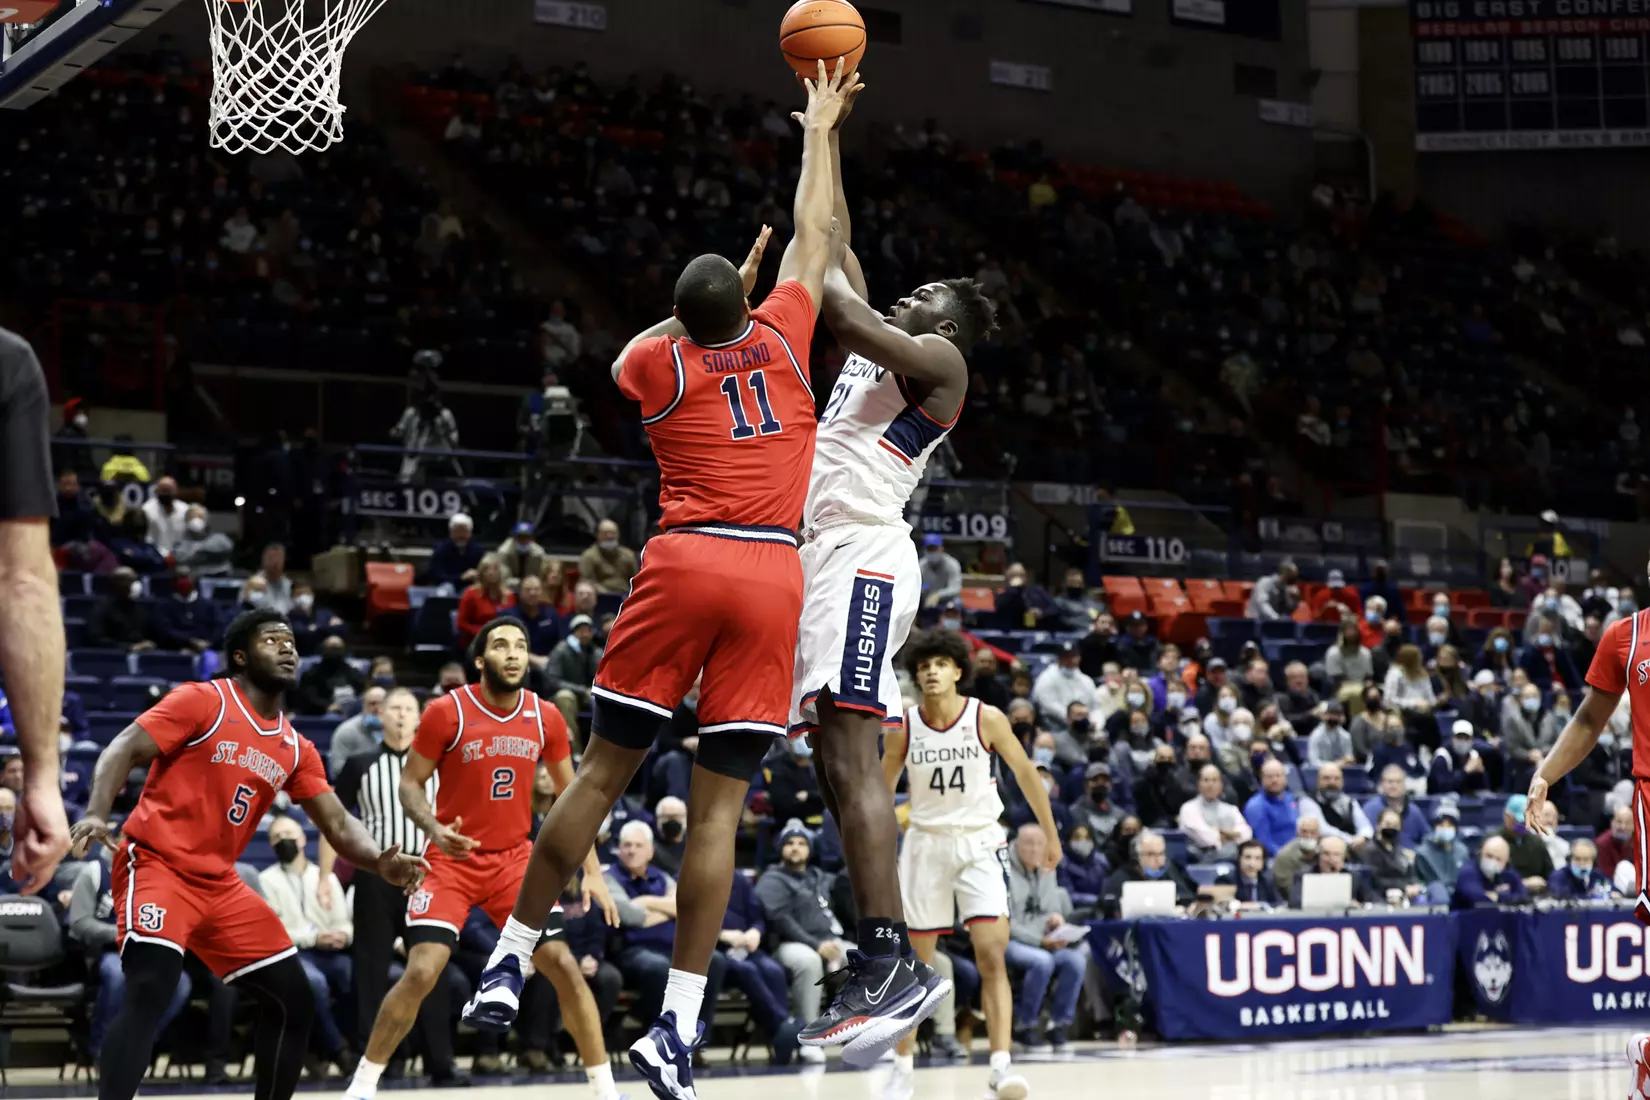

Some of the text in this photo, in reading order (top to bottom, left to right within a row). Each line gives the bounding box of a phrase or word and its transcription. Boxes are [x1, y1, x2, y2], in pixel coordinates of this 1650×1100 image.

[1416, 0, 1461, 18] BIG
[1474, 0, 1540, 16] EAST
[703, 343, 771, 374] SORIANO
[840, 357, 887, 383] CONN
[720, 369, 783, 441] 11
[820, 382, 854, 424] 21
[360, 487, 461, 516] SEC 109
[923, 513, 1007, 540] SEC 109
[1108, 536, 1185, 562] SEC 110
[854, 583, 880, 692] HUSKIES
[485, 736, 540, 762] JOHN'S
[911, 745, 979, 764] UCONN
[238, 746, 288, 793] JOHN'S
[490, 767, 515, 801] 2
[929, 765, 965, 796] 44
[227, 783, 257, 826] 5
[875, 927, 893, 939] 23
[1205, 924, 1425, 997] UCONN
[1565, 921, 1650, 983] UC
[1240, 998, 1391, 1027] BASKETBALL
[1592, 991, 1650, 1011] BASK
